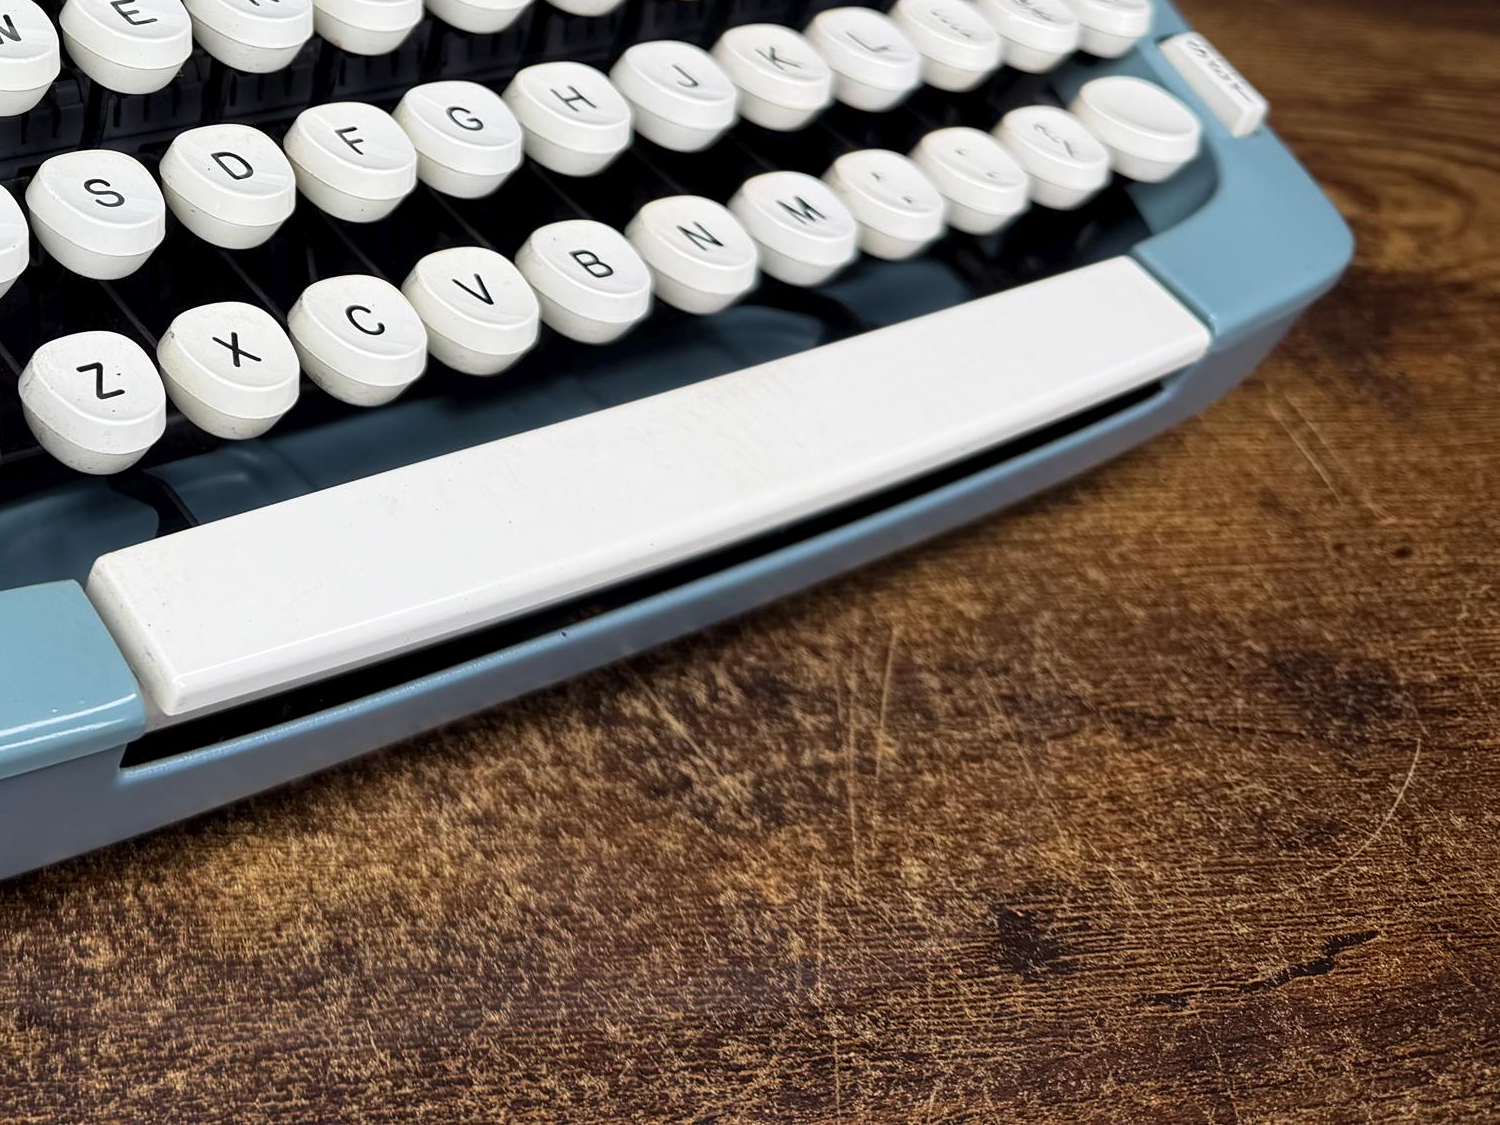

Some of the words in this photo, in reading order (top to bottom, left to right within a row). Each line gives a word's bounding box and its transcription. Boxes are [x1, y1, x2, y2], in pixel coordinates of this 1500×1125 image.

[846, 32, 893, 53] L
[756, 47, 801, 70] K
[673, 65, 699, 88] J
[551, 86, 596, 112] H
[446, 107, 483, 131] G
[335, 127, 363, 155] F
[211, 152, 253, 180] D
[84, 179, 125, 207] S
[777, 196, 826, 224] M
[677, 222, 724, 251] N
[569, 250, 613, 278] B
[452, 274, 494, 305] V
[346, 305, 385, 335] C
[212, 332, 261, 367] X
[76, 362, 125, 399] Z
